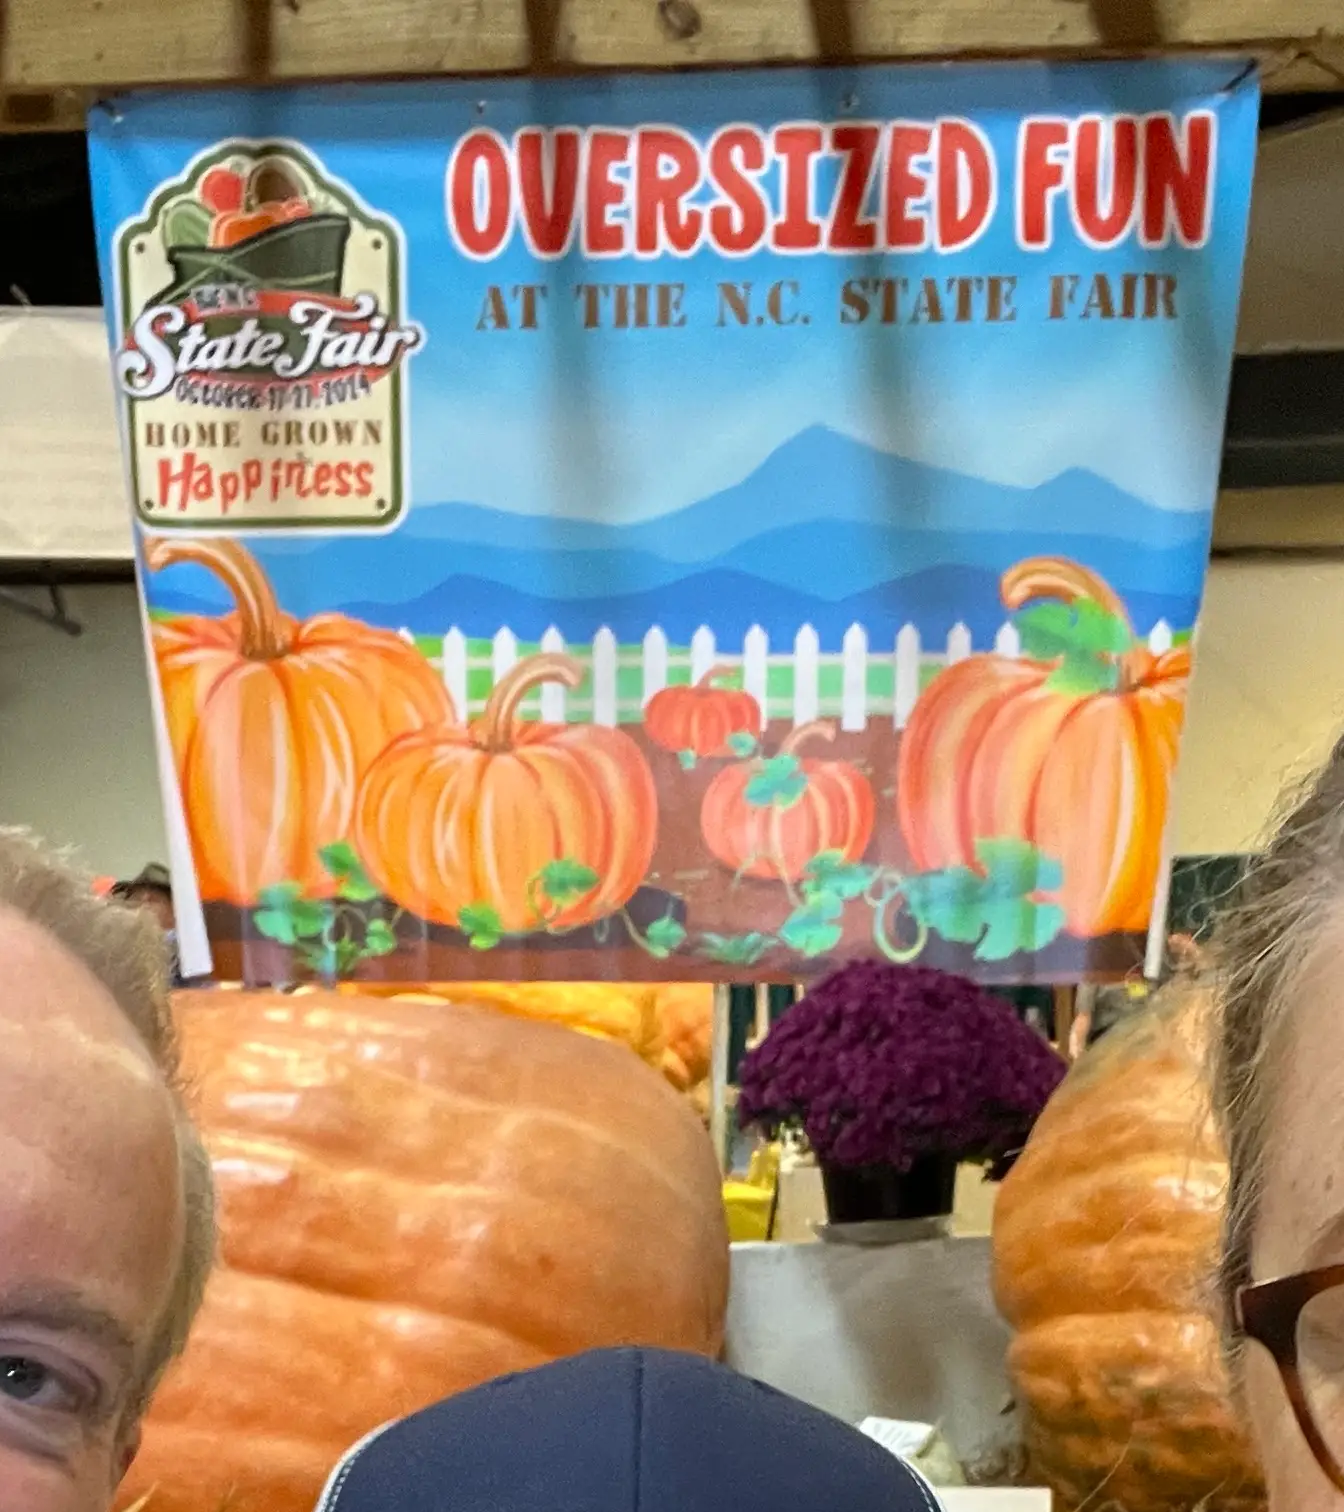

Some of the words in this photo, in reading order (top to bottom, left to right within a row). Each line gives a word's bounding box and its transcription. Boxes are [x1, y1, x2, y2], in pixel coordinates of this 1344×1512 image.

[447, 119, 994, 259] OVERSIZED
[1019, 114, 1215, 248] FUN
[475, 285, 549, 332] AT
[573, 283, 687, 329] THE
[715, 280, 811, 327] N.C.
[840, 276, 1018, 325] STATE
[1048, 273, 1179, 321] FAIR
[118, 303, 284, 398] State
[274, 294, 418, 377] Fair
[145, 421, 240, 448] HOME
[260, 419, 384, 446] GROWN
[157, 452, 375, 514] Happiness
